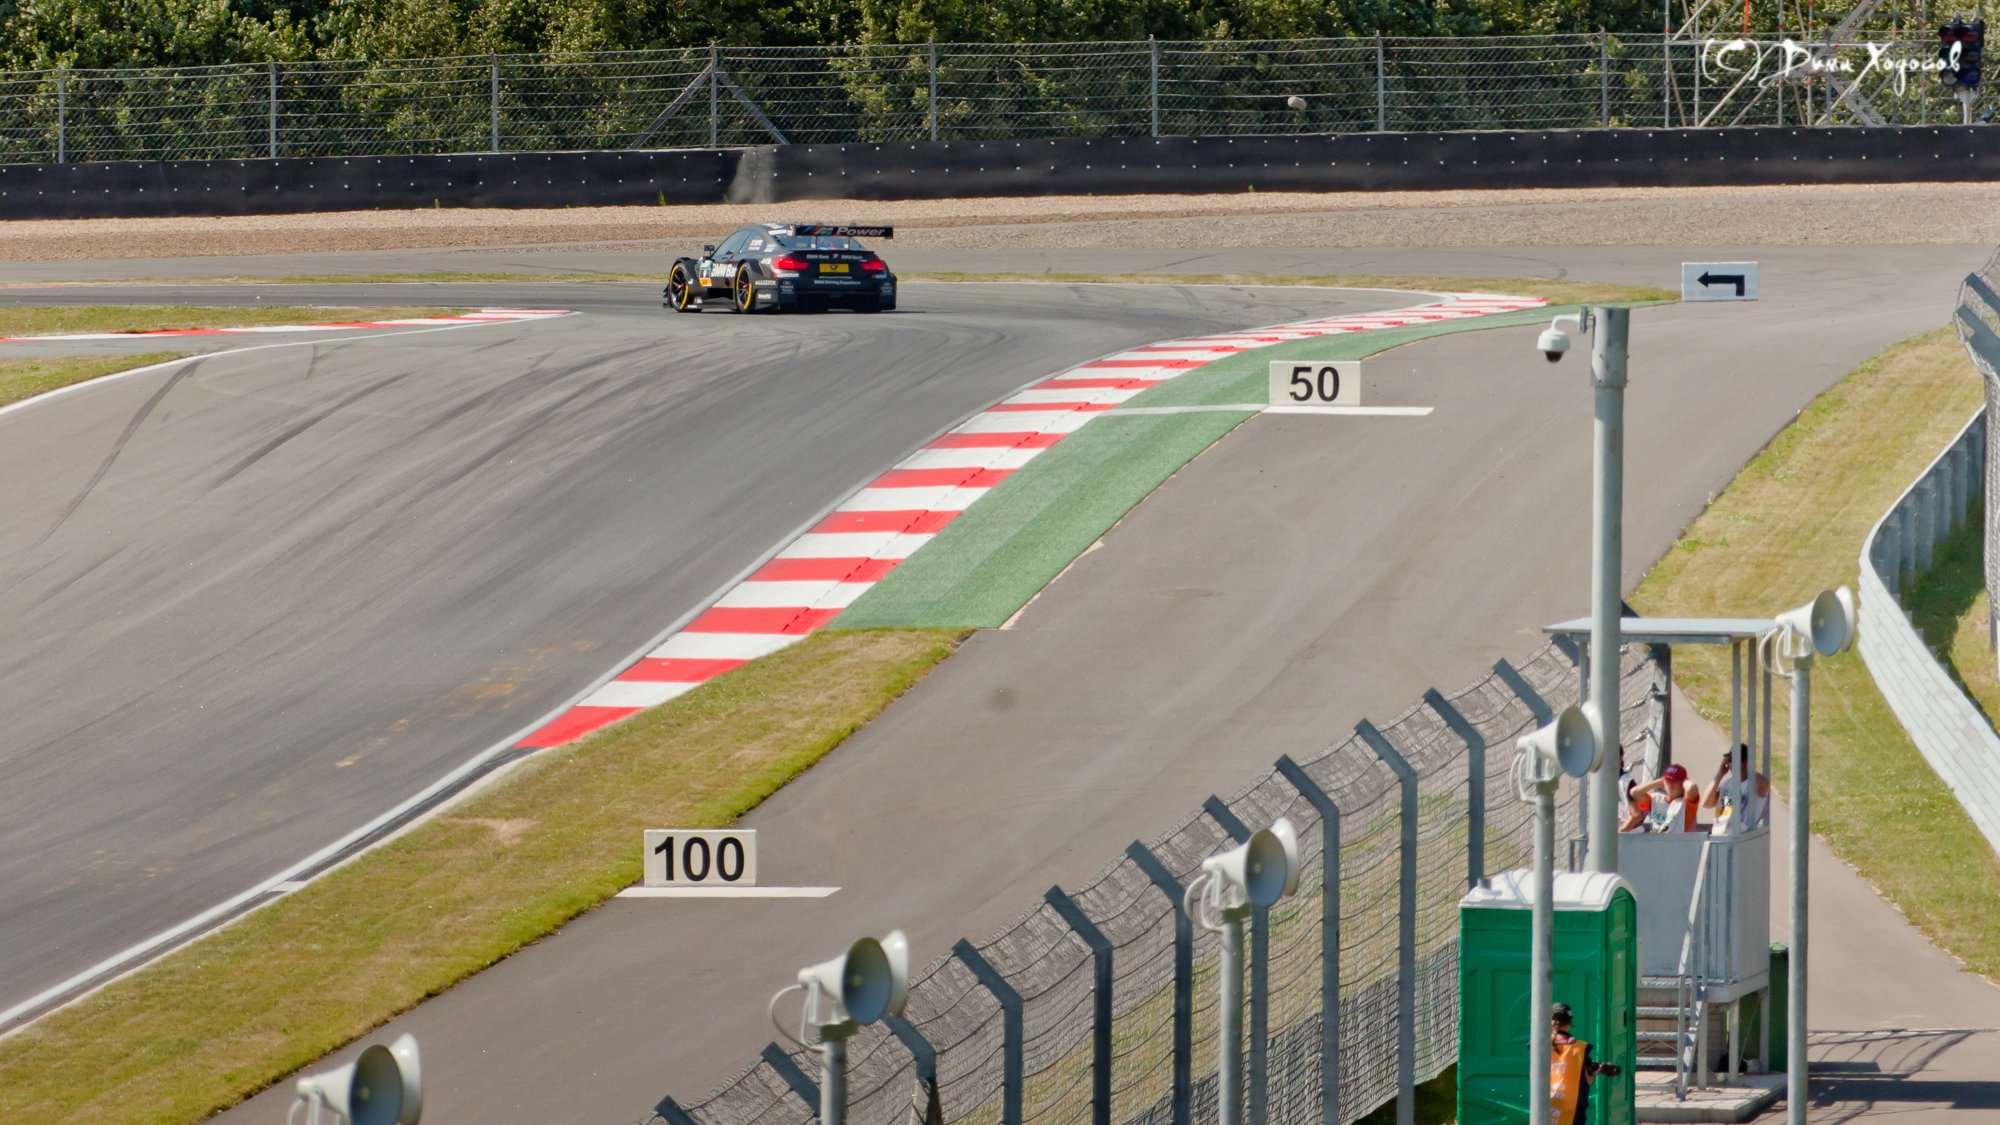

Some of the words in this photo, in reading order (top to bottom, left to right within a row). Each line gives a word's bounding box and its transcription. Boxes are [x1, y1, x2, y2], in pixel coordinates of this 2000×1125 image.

[836, 225, 886, 237] Power
[711, 263, 727, 277] BMW
[1289, 366, 1340, 402] 50
[654, 836, 745, 882] 100
